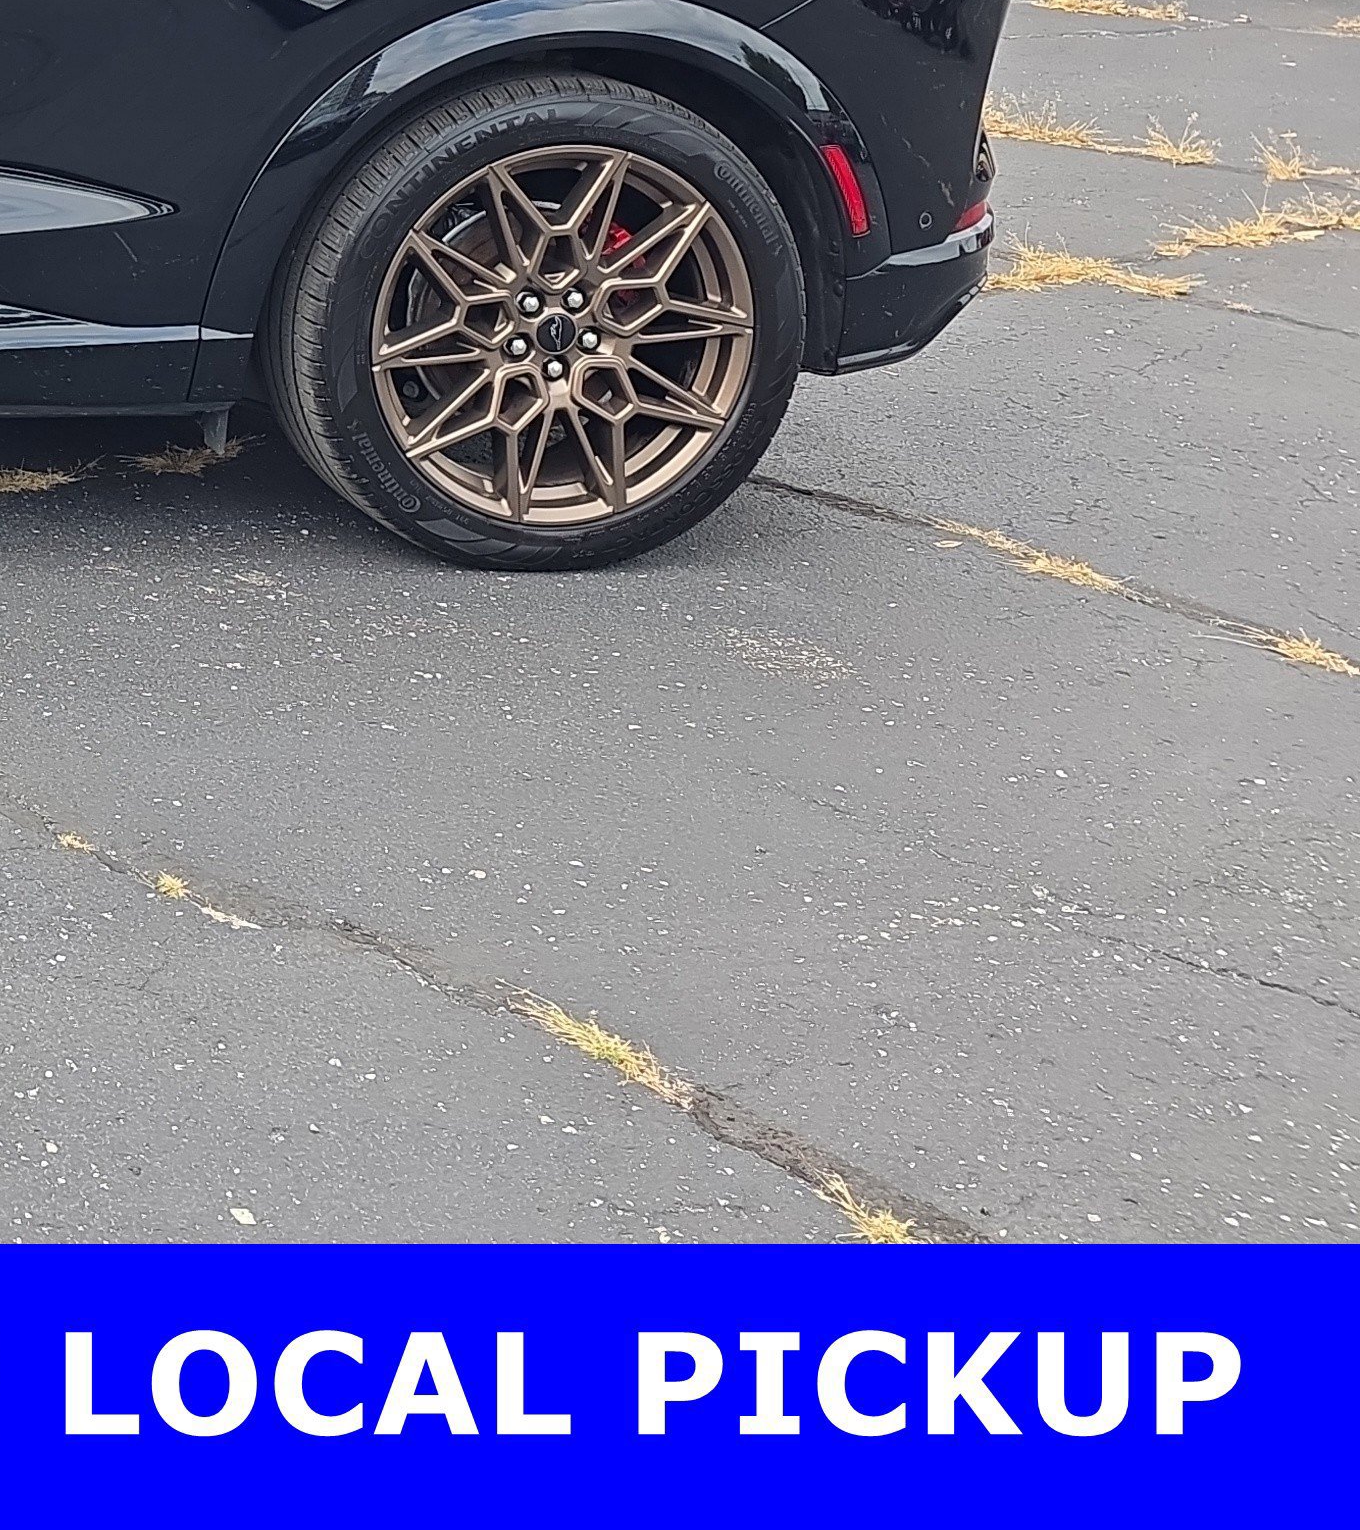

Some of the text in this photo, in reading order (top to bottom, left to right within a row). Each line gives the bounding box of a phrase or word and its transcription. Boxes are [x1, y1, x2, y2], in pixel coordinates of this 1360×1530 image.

[360, 108, 560, 259] CONTINENTAL
[713, 159, 780, 246] Continental
[351, 431, 421, 513] Continental
